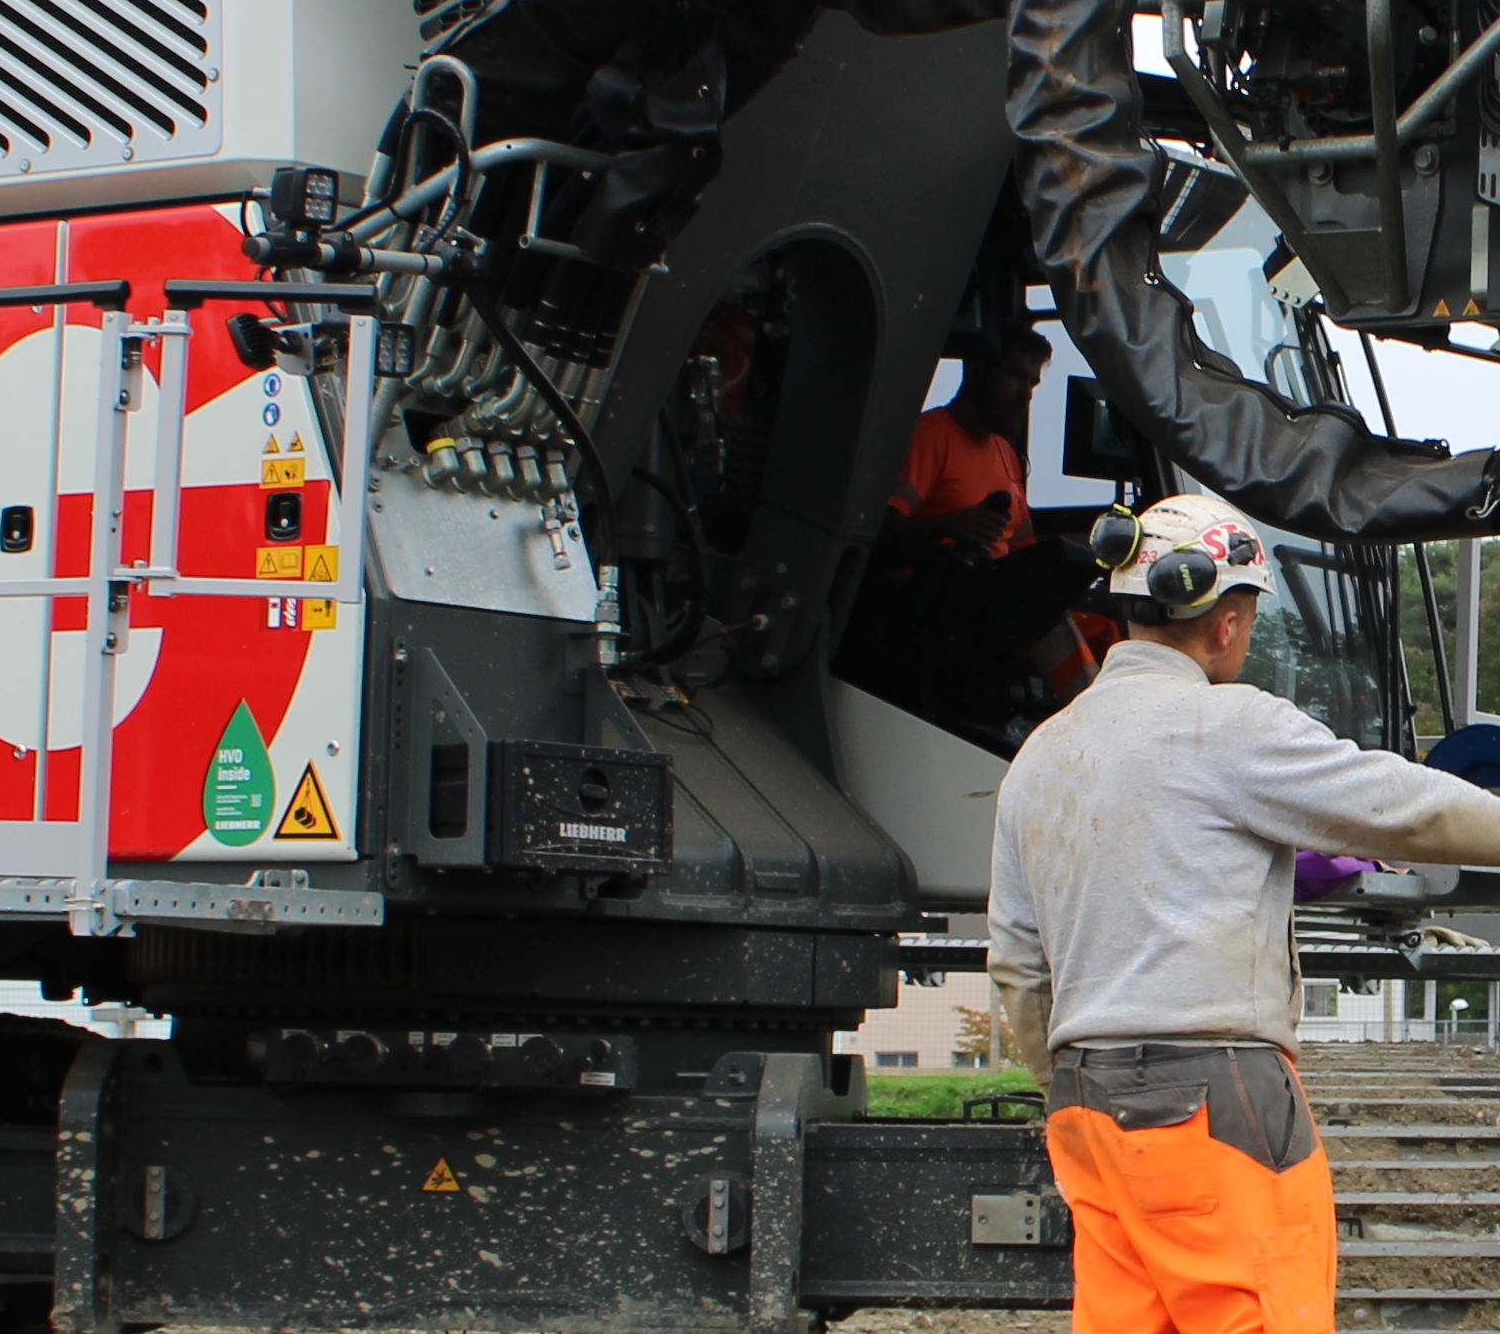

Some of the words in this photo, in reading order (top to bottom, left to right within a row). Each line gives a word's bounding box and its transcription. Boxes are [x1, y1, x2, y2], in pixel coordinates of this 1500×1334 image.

[218, 749, 243, 764] HVO
[217, 766, 251, 781] inside
[559, 823, 627, 842] LIEBHERR
